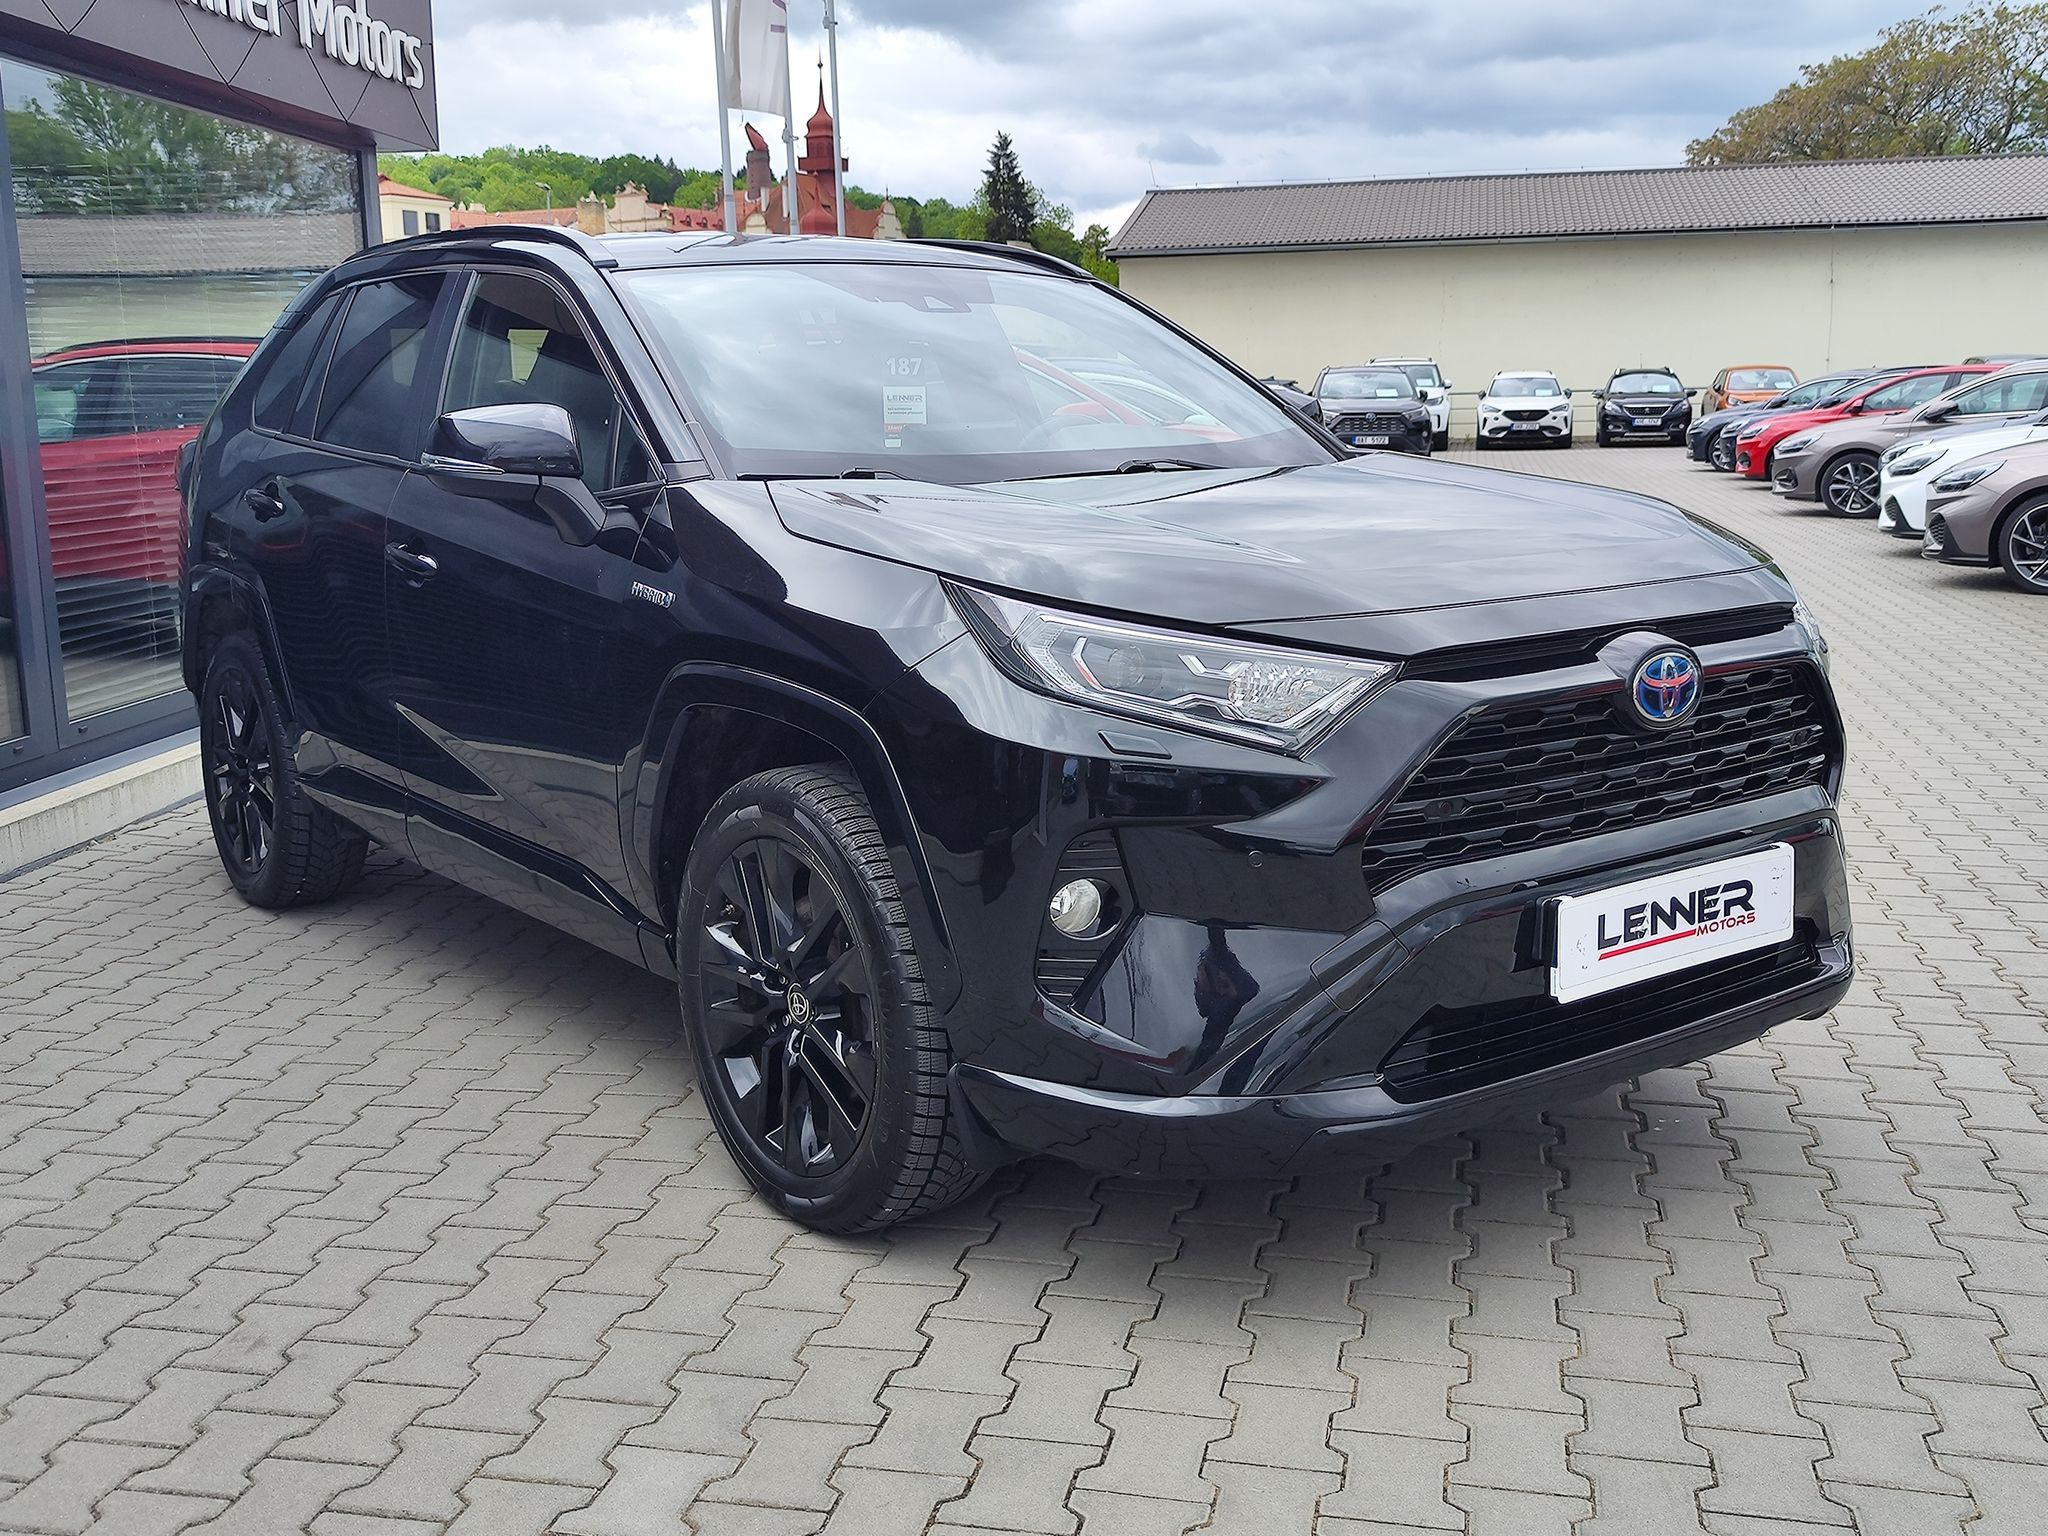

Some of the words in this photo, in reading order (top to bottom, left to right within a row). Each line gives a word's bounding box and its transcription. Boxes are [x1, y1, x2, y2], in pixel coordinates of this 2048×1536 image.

[297, 0, 424, 90] Motors
[887, 357, 922, 376] 187
[1597, 879, 1755, 950] LENNER
[1697, 912, 1756, 936] MOTORS
